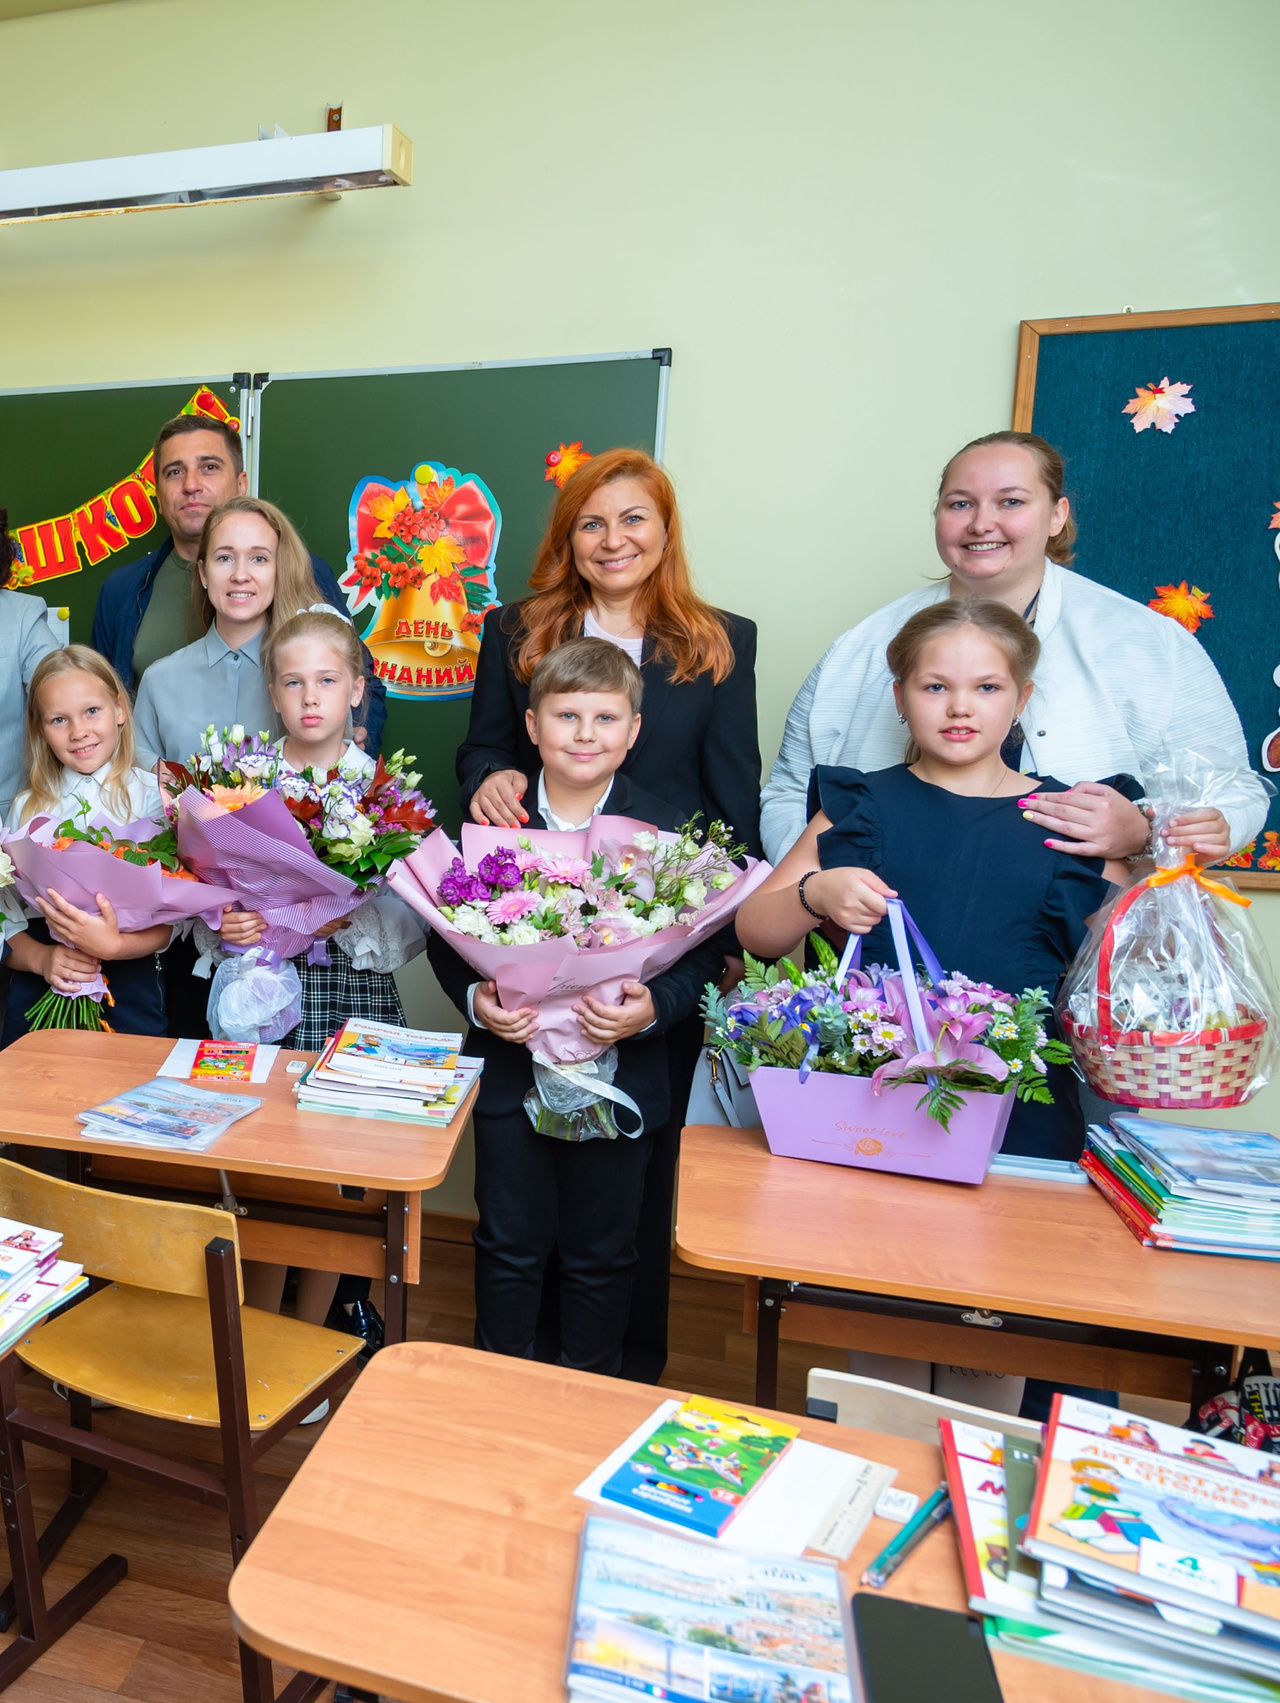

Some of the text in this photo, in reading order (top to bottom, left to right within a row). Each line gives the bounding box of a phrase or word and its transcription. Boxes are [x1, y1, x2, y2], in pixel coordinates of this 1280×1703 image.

[16, 390, 241, 584] ШКО!
[394, 619, 454, 640] ДЕНЬ
[373, 658, 475, 687] ЗНАНИЙ
[834, 1119, 877, 1135] Sweet
